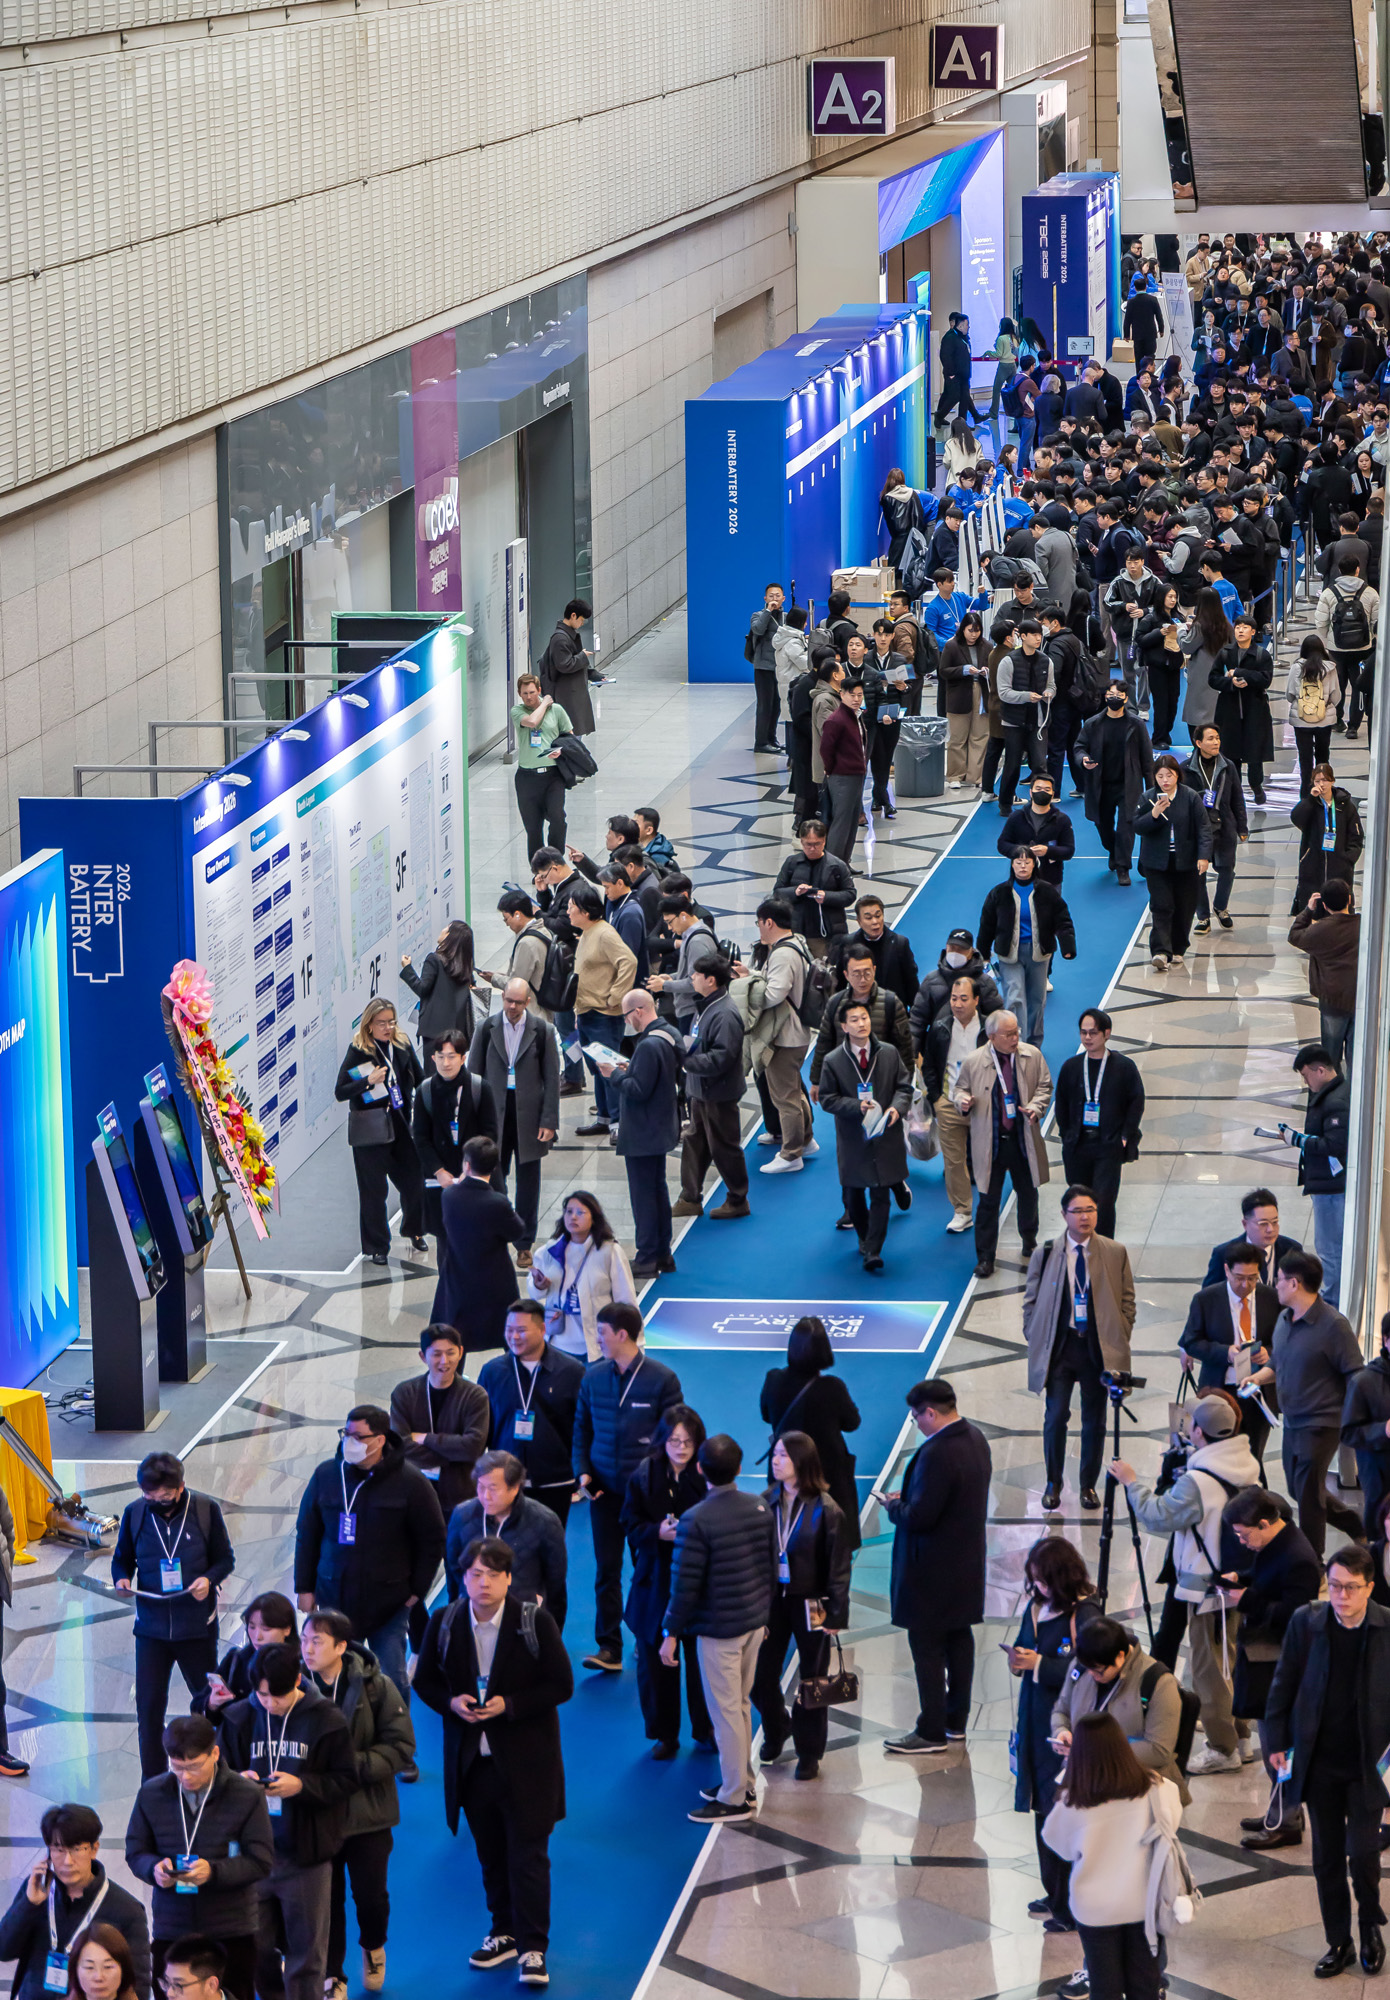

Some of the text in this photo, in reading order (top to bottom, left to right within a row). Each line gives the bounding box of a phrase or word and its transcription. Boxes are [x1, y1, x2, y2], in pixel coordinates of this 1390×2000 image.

[940, 35, 992, 81] A1
[817, 72, 882, 125] A2
[1039, 215, 1049, 248] TBC
[1060, 214, 1068, 264] INTERBATTERY
[727, 429, 739, 535] INTERBATTERY 2026
[427, 477, 460, 541] coex
[264, 531, 275, 553] Hall
[223, 790, 237, 815] 2026
[116, 863, 132, 902] 2026
[395, 849, 407, 892] 3F
[69, 864, 92, 952] BATTERY
[93, 864, 115, 926] INTER
[301, 953, 313, 1000] 1F
[369, 953, 381, 999] 2F
[11, 1018, 26, 1046] MAP
